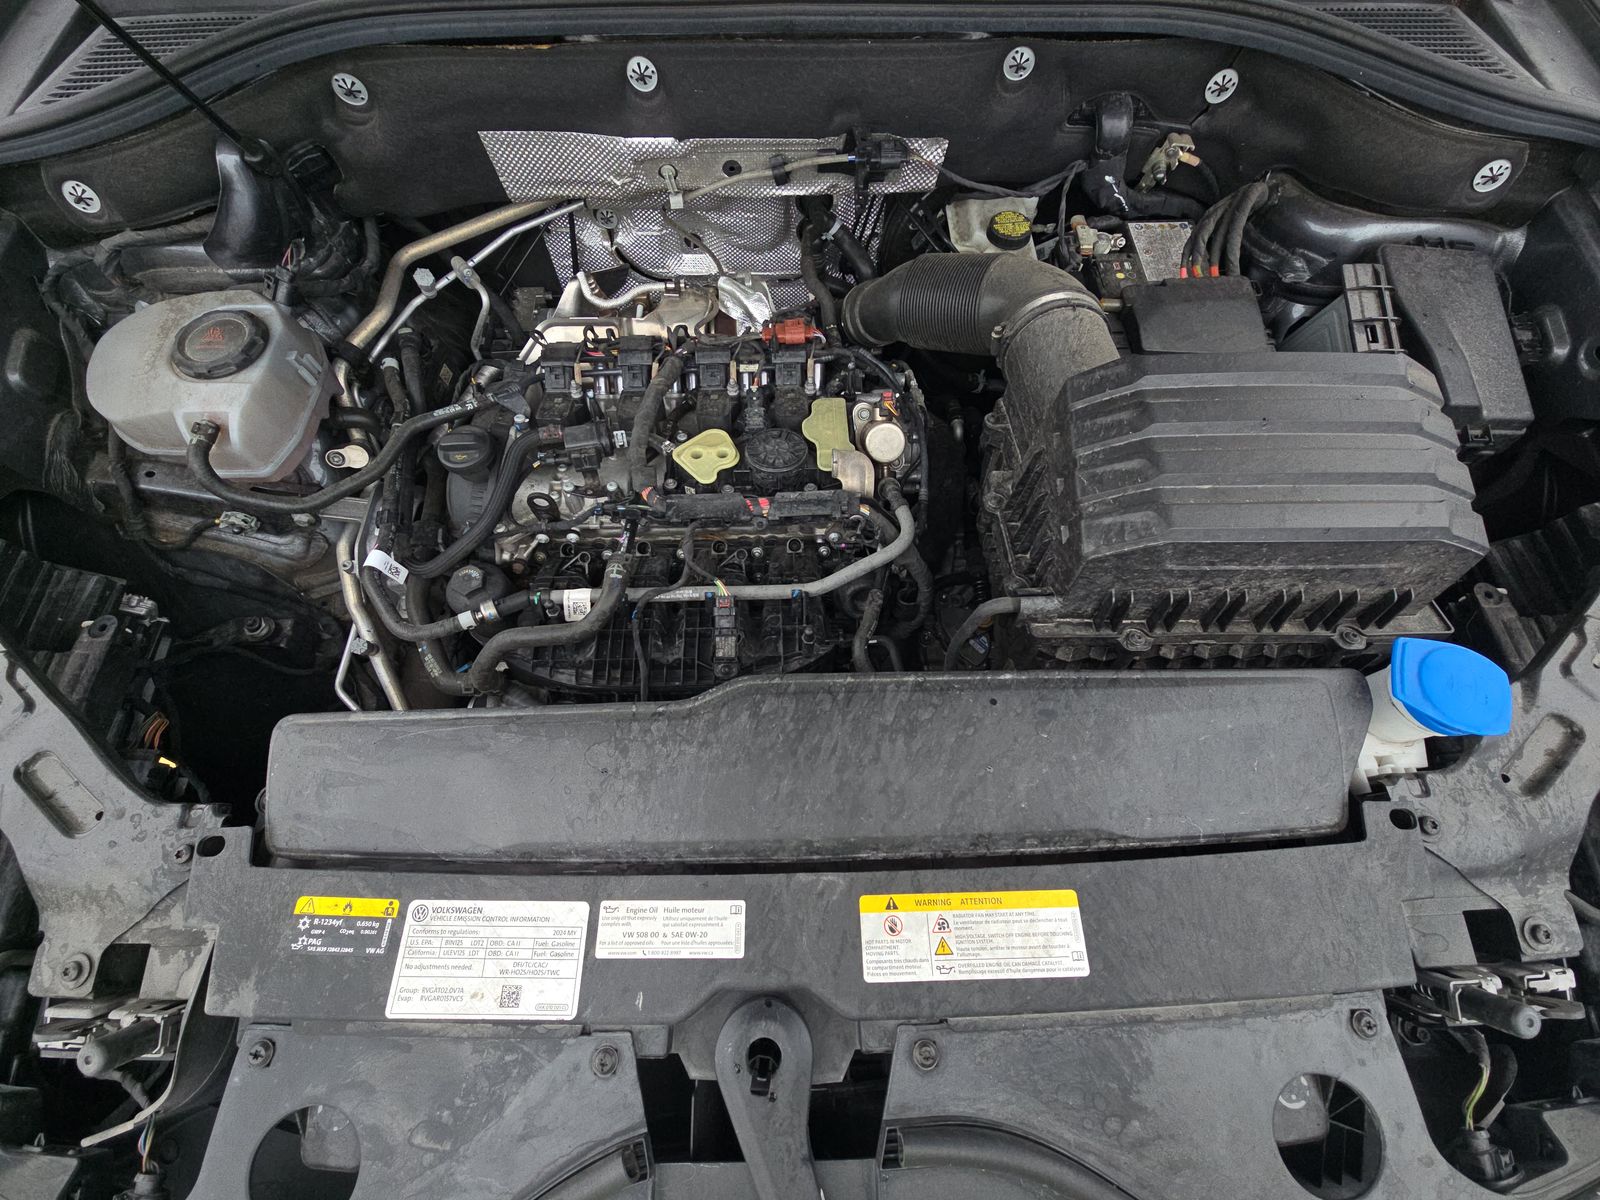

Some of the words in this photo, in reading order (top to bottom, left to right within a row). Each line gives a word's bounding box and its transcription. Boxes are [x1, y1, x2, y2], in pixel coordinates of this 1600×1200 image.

[960, 897, 1002, 905] ATTENTION
[626, 907, 648, 915] Engine
[313, 918, 343, 927] R-1234yf
[400, 987, 420, 995] Group:
[397, 995, 413, 1003] Evap:
